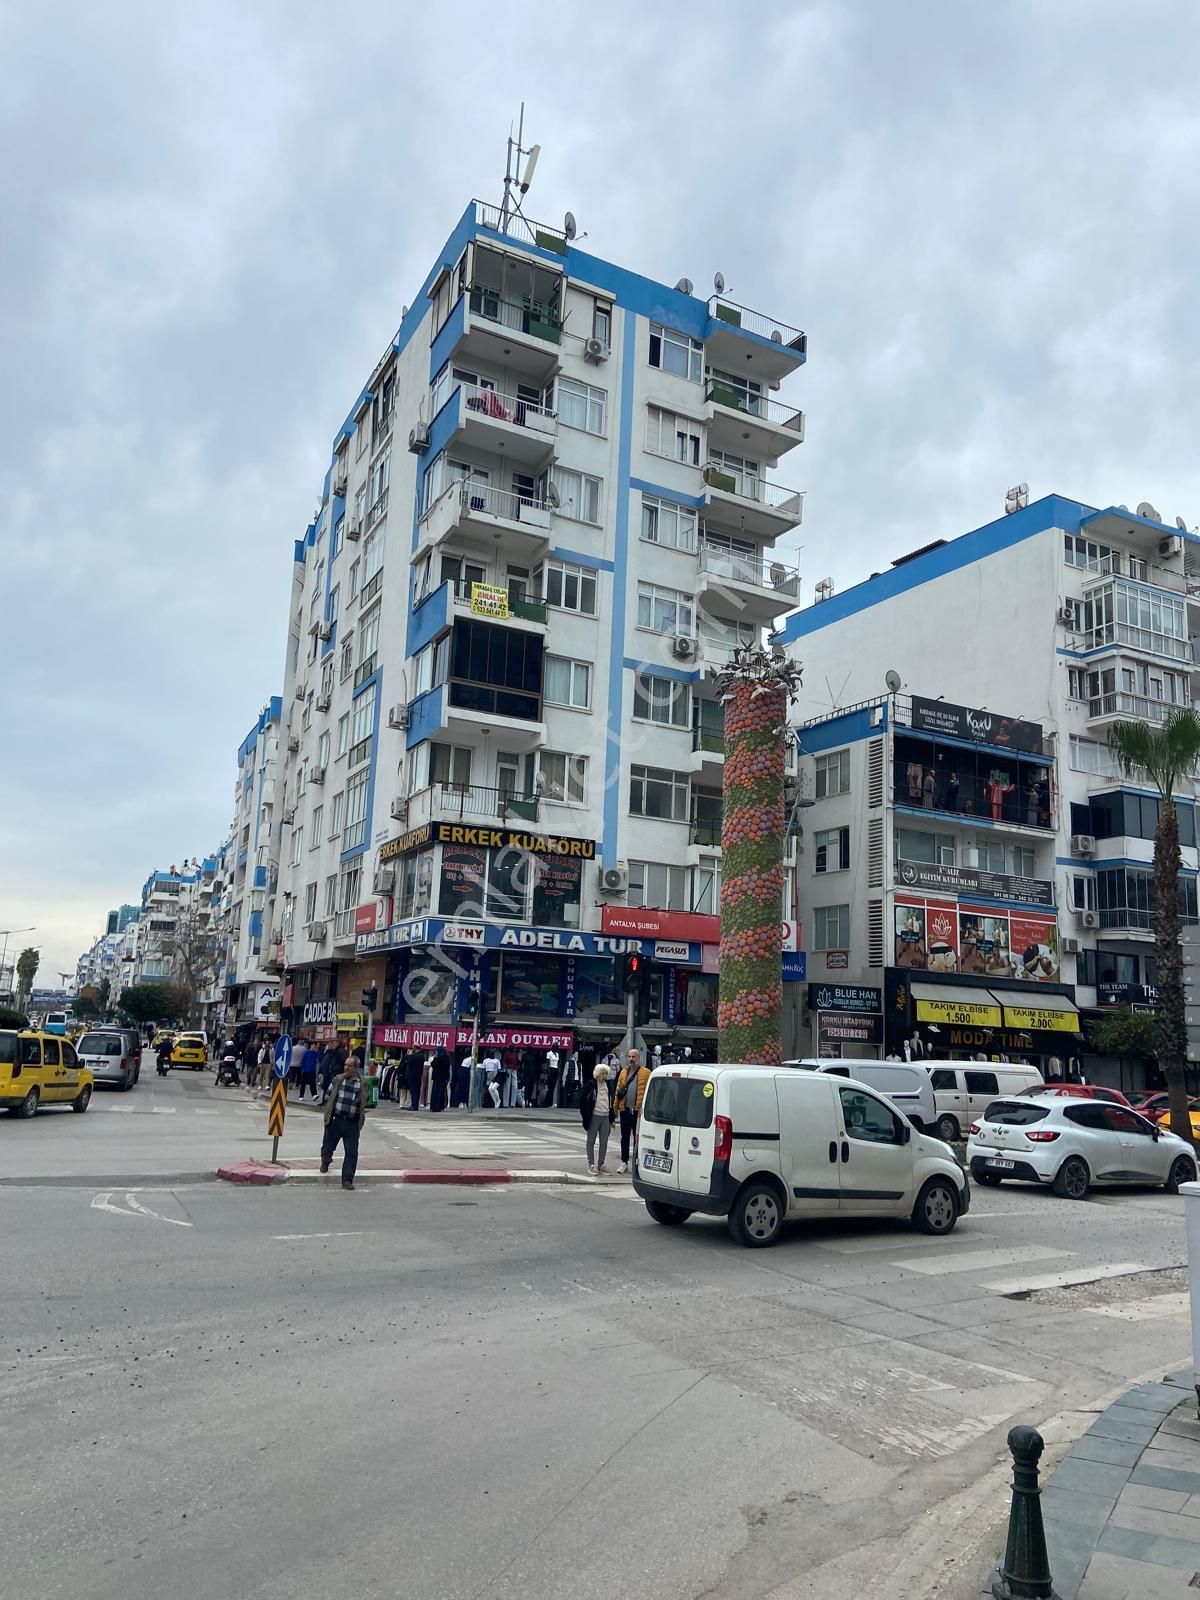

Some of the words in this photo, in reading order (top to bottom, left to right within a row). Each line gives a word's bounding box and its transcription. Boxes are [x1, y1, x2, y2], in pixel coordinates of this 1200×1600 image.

[439, 825, 503, 847] ERKEK
[508, 834, 593, 857] KUAFÖRÜ
[379, 839, 400, 858] ERKEK
[609, 919, 637, 929] ANTALYA
[637, 922, 660, 931] ŞUBESİ
[457, 928, 483, 939] THY
[501, 929, 586, 951] ADELA
[593, 936, 643, 954] TUR
[656, 946, 688, 955] PEGASUS
[566, 958, 576, 1015] ONURAIR
[835, 988, 857, 998] BLUE
[859, 990, 877, 999] HAN
[303, 1003, 326, 1023] CADDE
[929, 1002, 956, 1012] TAKIM
[958, 1005, 989, 1014] ELBİSE
[1012, 1009, 1036, 1017] TAKIM
[1038, 1011, 1065, 1020] ELBİSE
[821, 1016, 842, 1025] KORKU
[384, 1028, 409, 1043] BAYAN
[412, 1030, 449, 1047] OUTLET
[511, 1033, 571, 1046] OUTLET
[999, 1034, 1033, 1048] TIME
